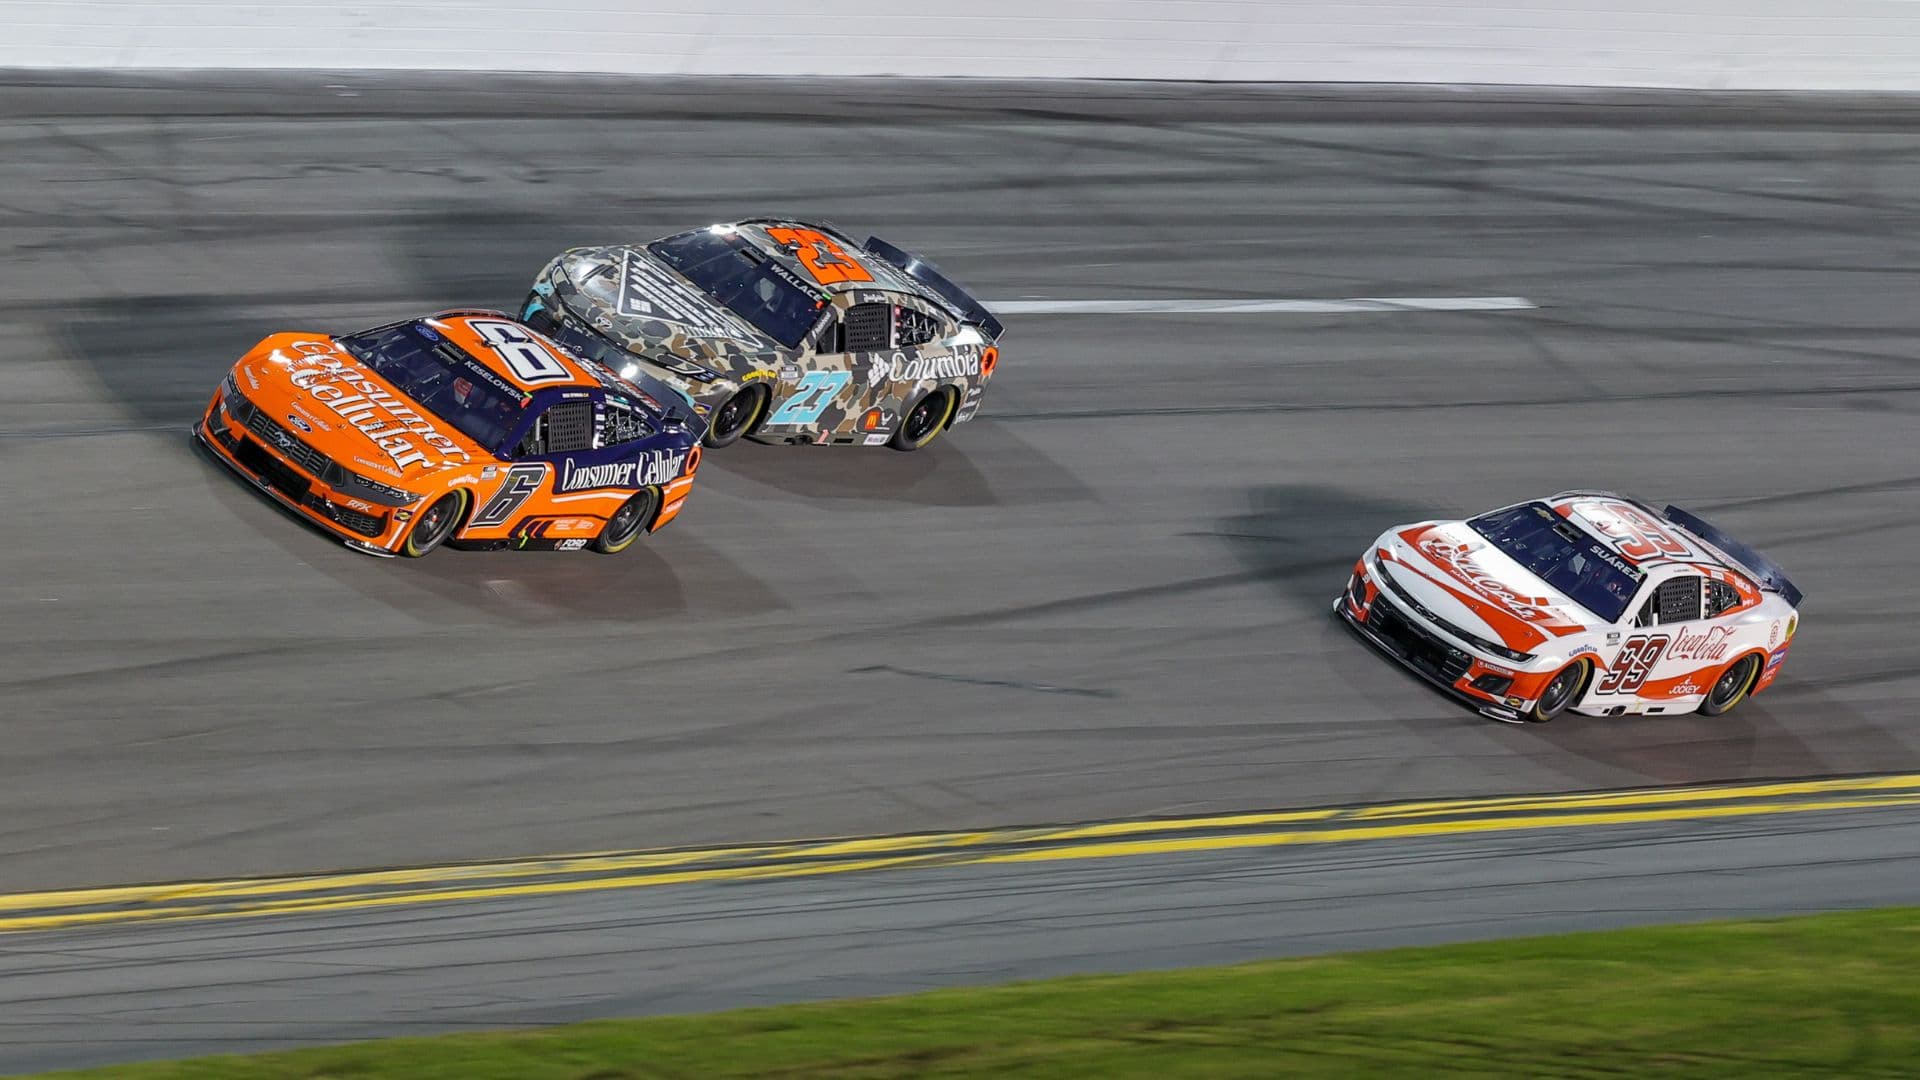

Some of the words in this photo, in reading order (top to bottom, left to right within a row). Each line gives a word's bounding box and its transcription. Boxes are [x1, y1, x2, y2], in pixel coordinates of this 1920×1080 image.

[765, 227, 875, 285] 23
[771, 264, 824, 303] WALLACE
[465, 318, 576, 385] 6
[889, 344, 979, 382] Columbia
[290, 367, 435, 472] Cellular
[291, 341, 472, 462] Consumer
[767, 371, 853, 425] 23
[470, 464, 547, 528] 6
[562, 457, 636, 491] Consumer
[636, 448, 685, 486] Cellular
[1595, 634, 1671, 695] 99
[1668, 685, 1702, 695] JOCKEY
